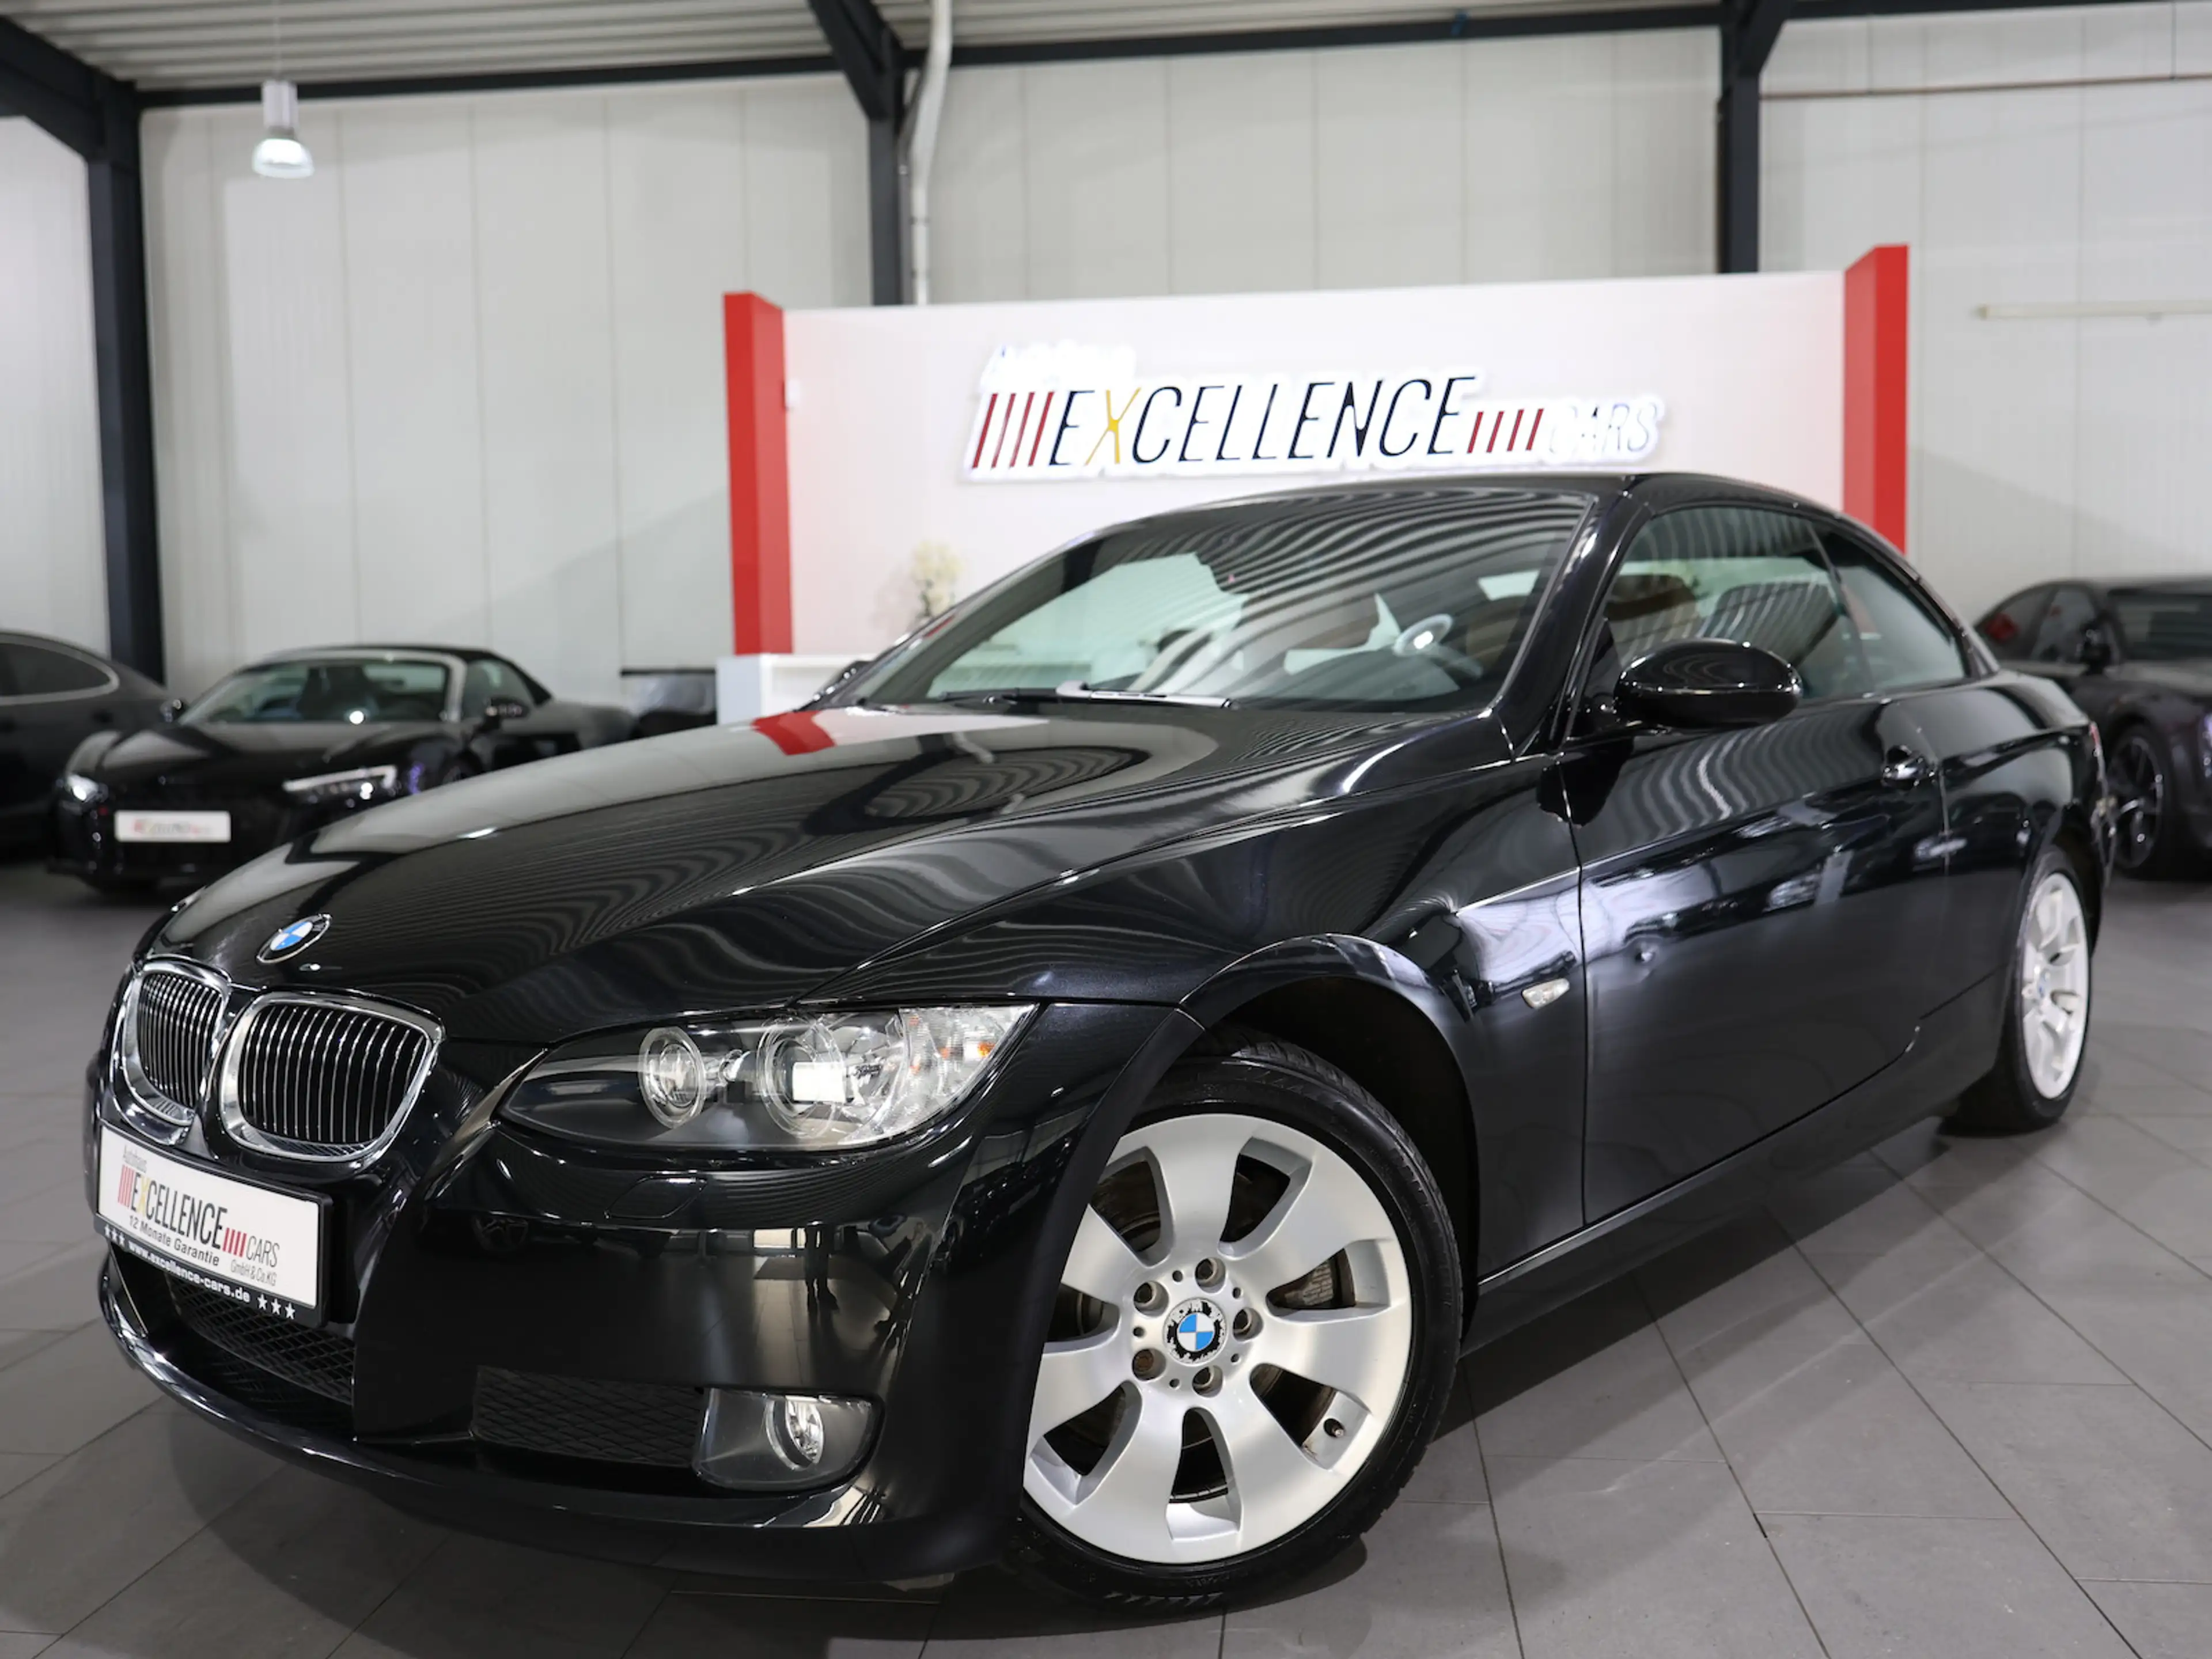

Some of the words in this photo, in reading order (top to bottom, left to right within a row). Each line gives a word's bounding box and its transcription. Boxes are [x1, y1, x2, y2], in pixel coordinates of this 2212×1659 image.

[1048, 376, 1476, 465] EXCELLENCE
[130, 1215, 139, 1229] 12
[140, 1221, 172, 1247] Monate
[174, 1238, 219, 1266] Garantie
[131, 1173, 228, 1249] EXCELLENCE
[246, 1236, 280, 1267] CARS
[128, 1240, 251, 1302] www.excellence-cars.de
